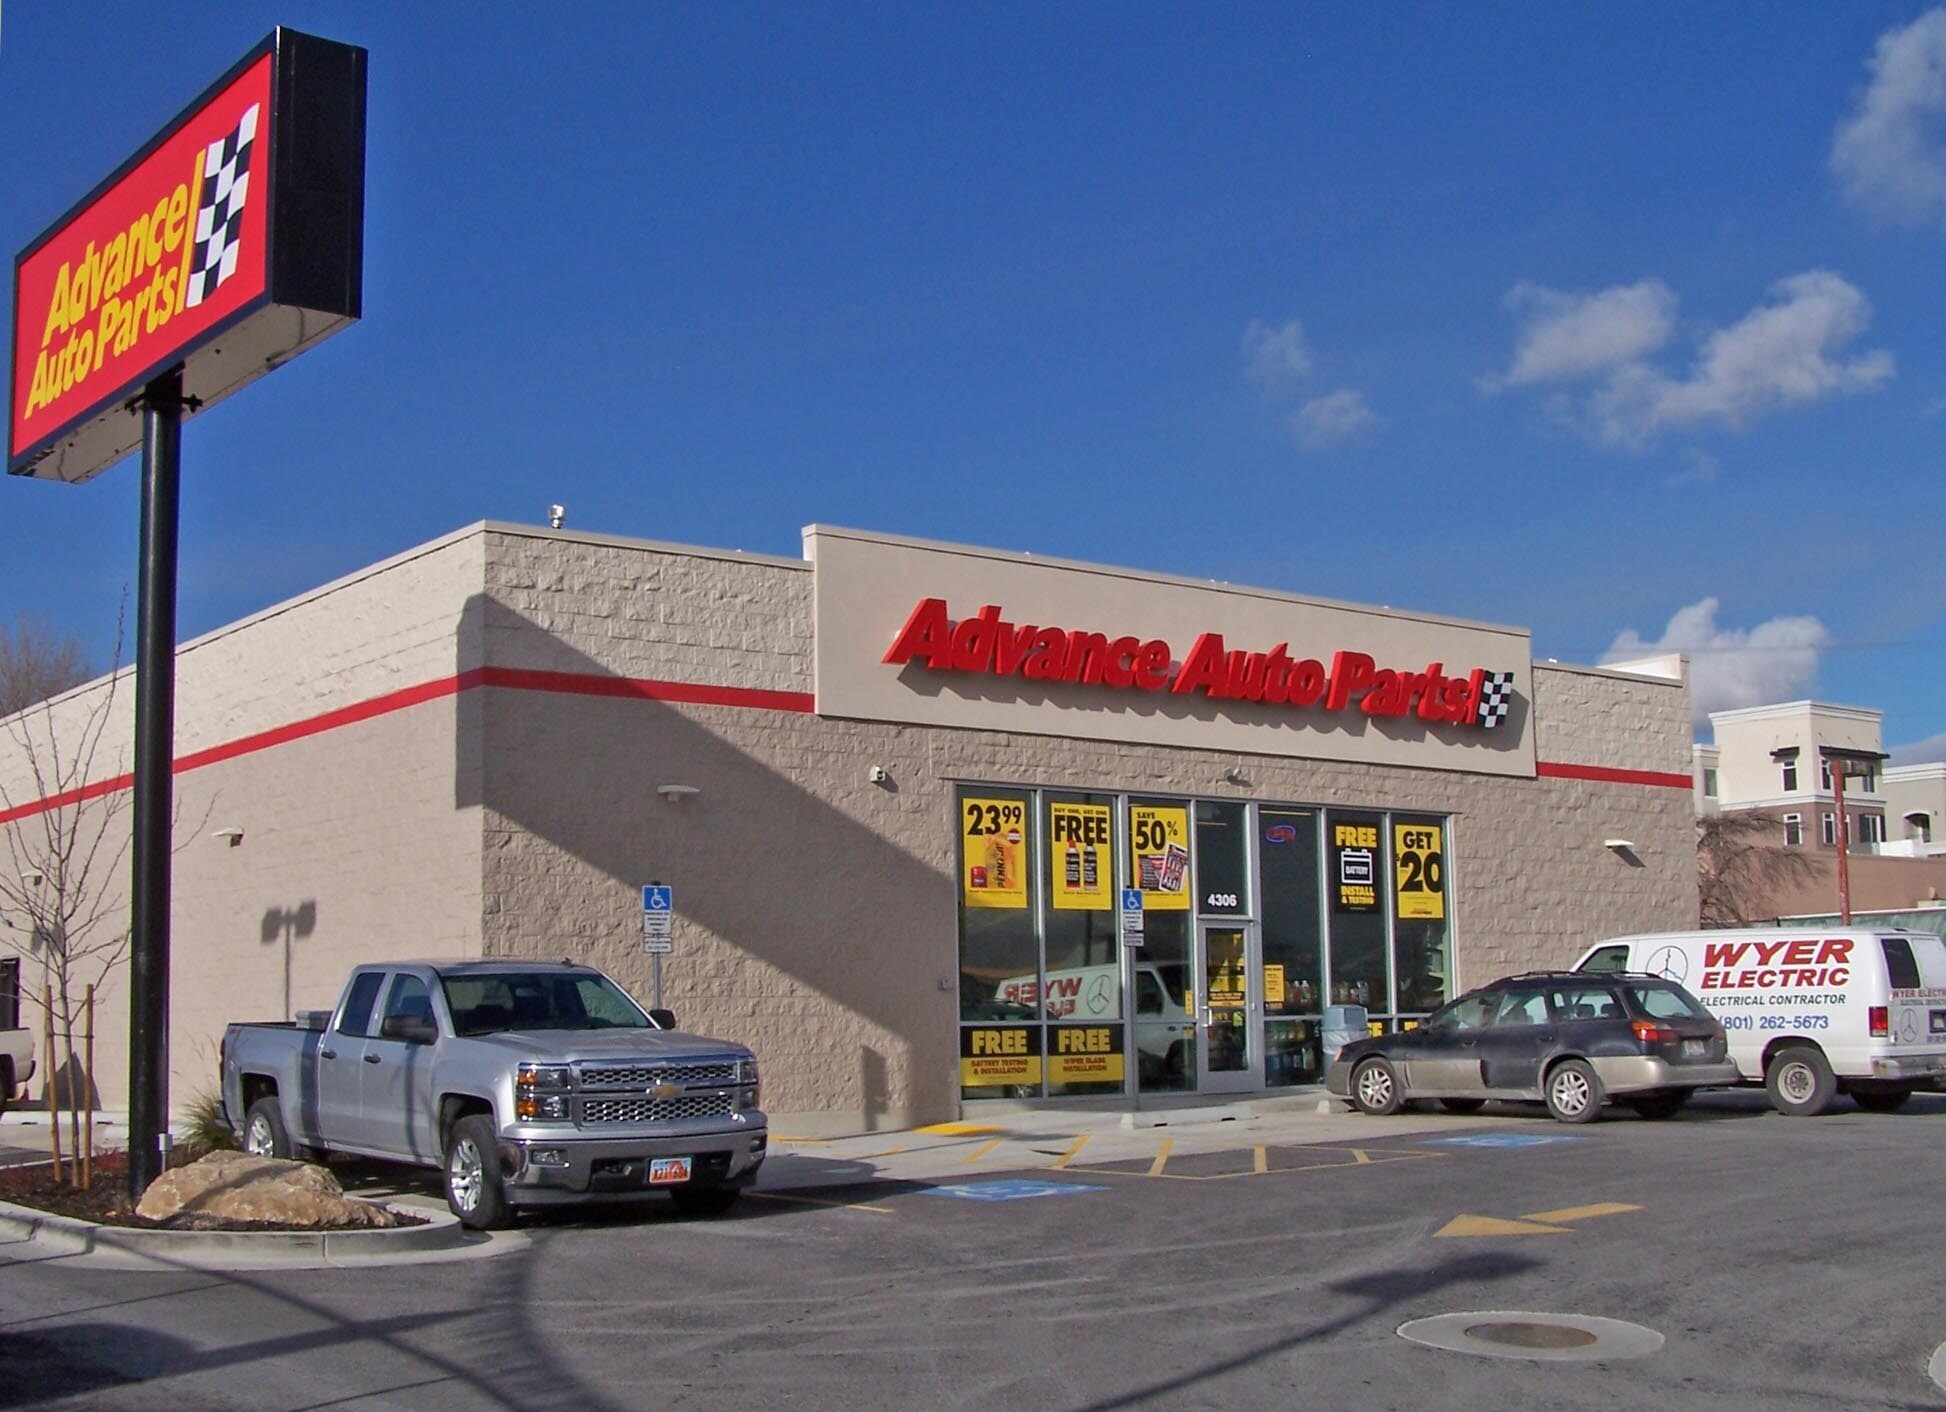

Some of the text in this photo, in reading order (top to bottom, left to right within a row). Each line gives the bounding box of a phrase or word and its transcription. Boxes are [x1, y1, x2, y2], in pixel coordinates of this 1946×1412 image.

[41, 183, 188, 349] Advance
[881, 598, 1471, 722] Advance Auto Parts
[1054, 815, 1108, 844] FREE
[1335, 825, 1377, 848] FREE
[1403, 831, 1433, 849] GET
[1207, 893, 1238, 907] 4306
[1341, 885, 1375, 897] INSTALL
[1704, 939, 1854, 968] WYER
[1700, 968, 1850, 989] ELECTRIC
[1700, 994, 1846, 1007] ELECTRICAL CONTRACTOR
[1760, 1015, 1829, 1029] 262-5673
[972, 1030, 1027, 1054] FREE
[1058, 1029, 1110, 1052] FREE
